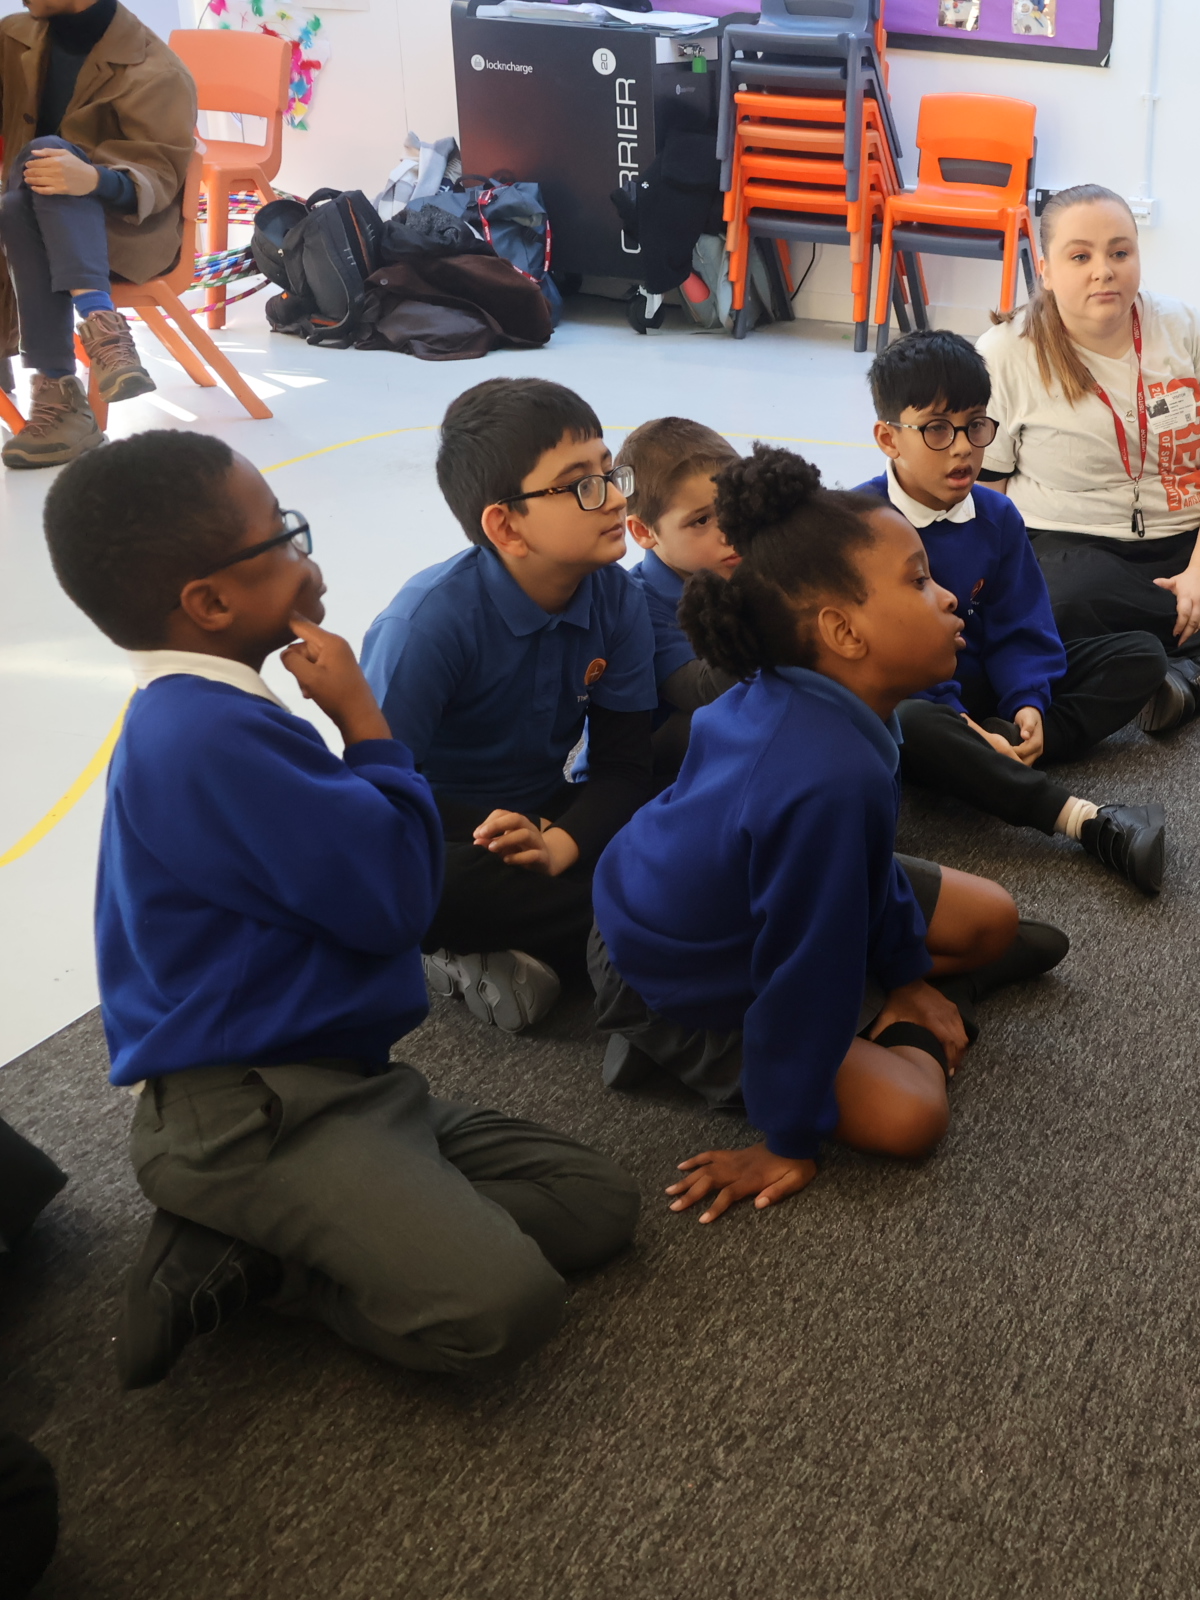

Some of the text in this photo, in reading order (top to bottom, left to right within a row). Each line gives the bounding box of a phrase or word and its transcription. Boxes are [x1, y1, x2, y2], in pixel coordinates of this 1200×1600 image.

[486, 59, 533, 75] lockncharge
[600, 53, 608, 70] 20
[615, 77, 641, 254] CRRIER
[1161, 436, 1171, 448] OF
